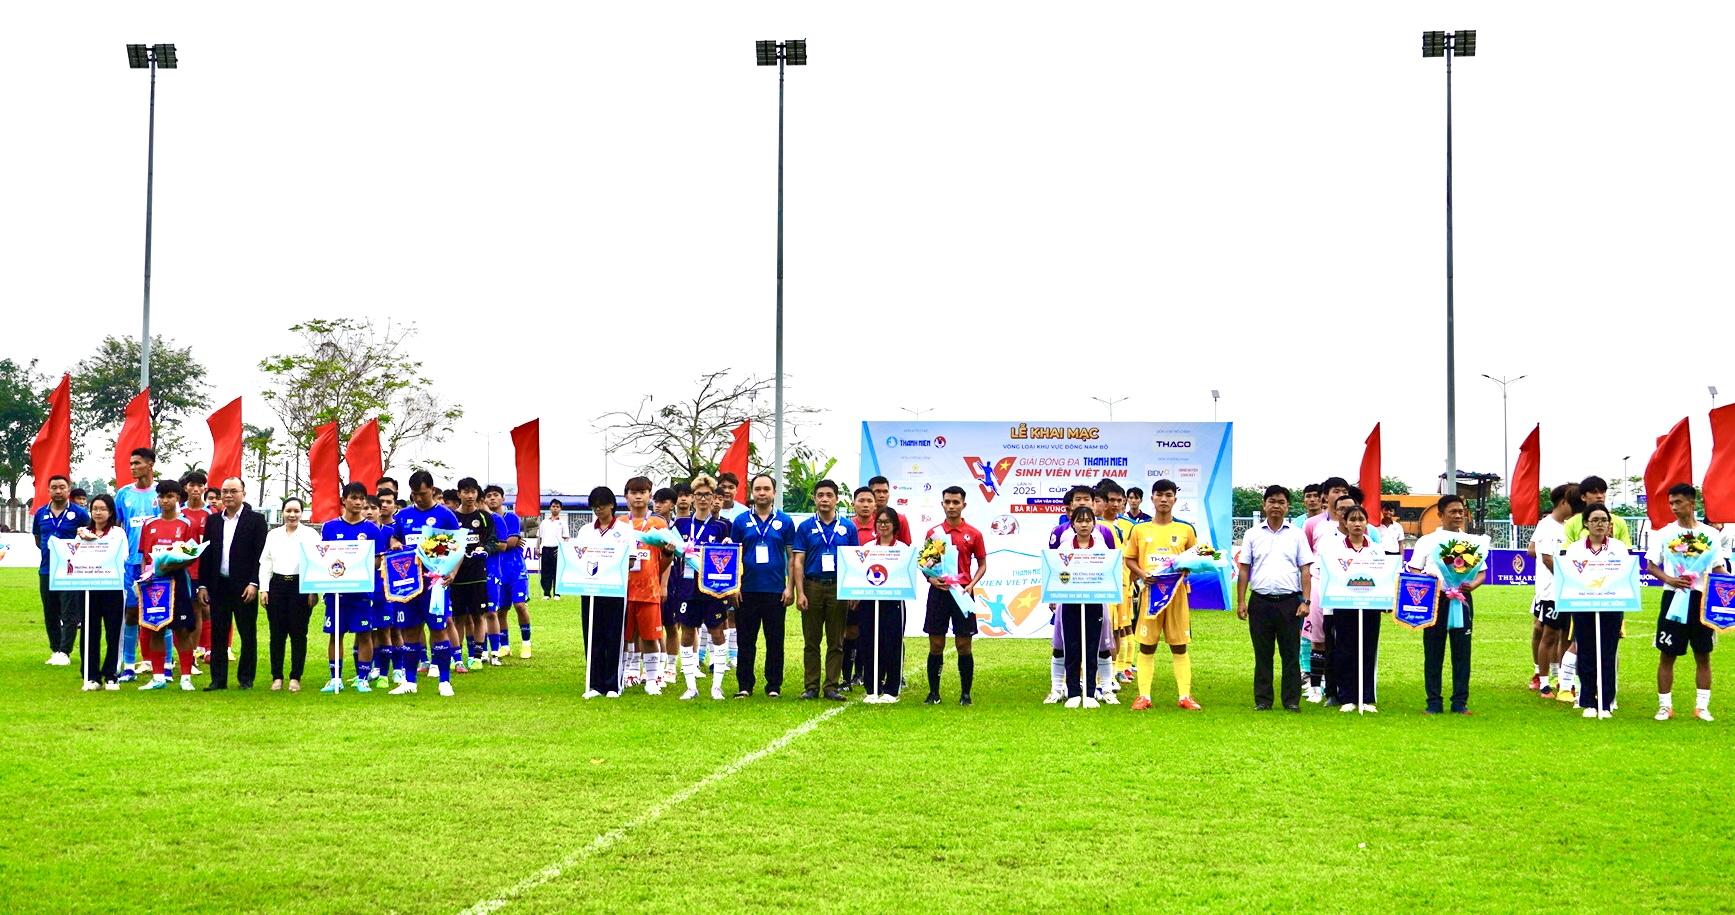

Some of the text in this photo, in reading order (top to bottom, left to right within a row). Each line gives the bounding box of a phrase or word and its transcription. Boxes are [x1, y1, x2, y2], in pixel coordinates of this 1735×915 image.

[1010, 422, 1100, 442] LỄ KHAI MẠC
[1084, 457, 1109, 466] THANH
[1015, 468, 1042, 477] SINH
[1046, 467, 1071, 477] VIÊN
[1075, 468, 1100, 478] VIỆT
[1013, 486, 1036, 494] 2025
[680, 602, 687, 614] 8
[1545, 607, 1558, 620] 20
[1659, 631, 1672, 646] 24
